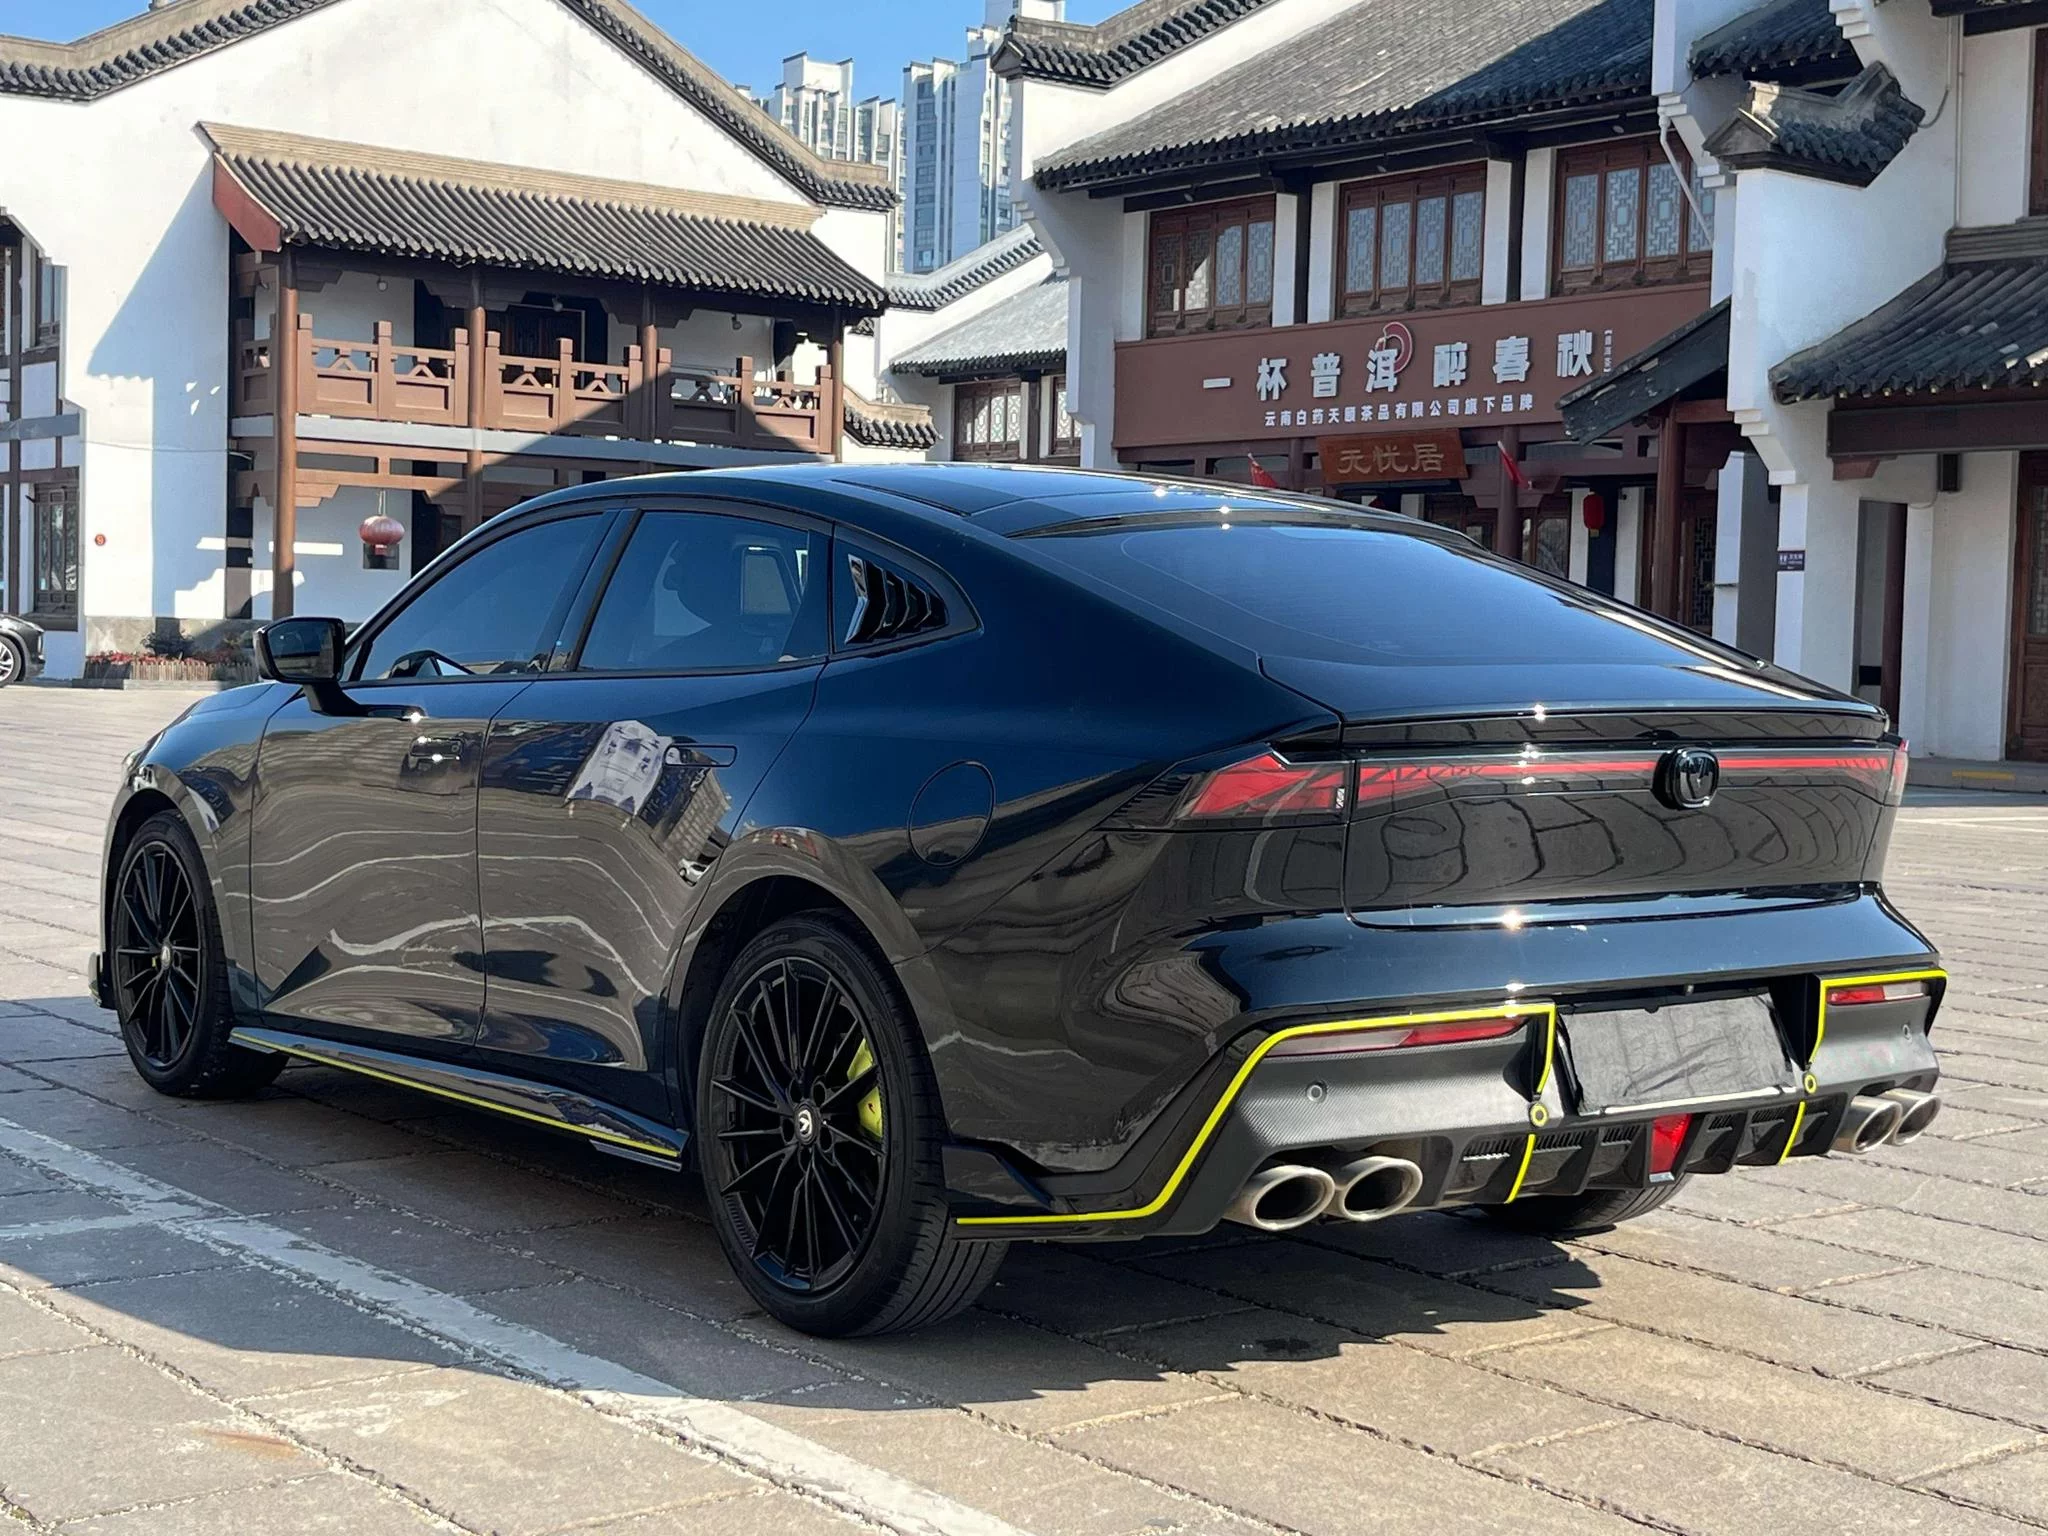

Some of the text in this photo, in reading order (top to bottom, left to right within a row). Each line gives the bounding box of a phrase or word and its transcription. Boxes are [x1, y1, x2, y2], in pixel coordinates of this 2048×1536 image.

[1203, 329, 1593, 401] 一杯普洱醉春秋
[1264, 393, 1533, 427] 云南白药天颐茶品有限公司旗下品牌
